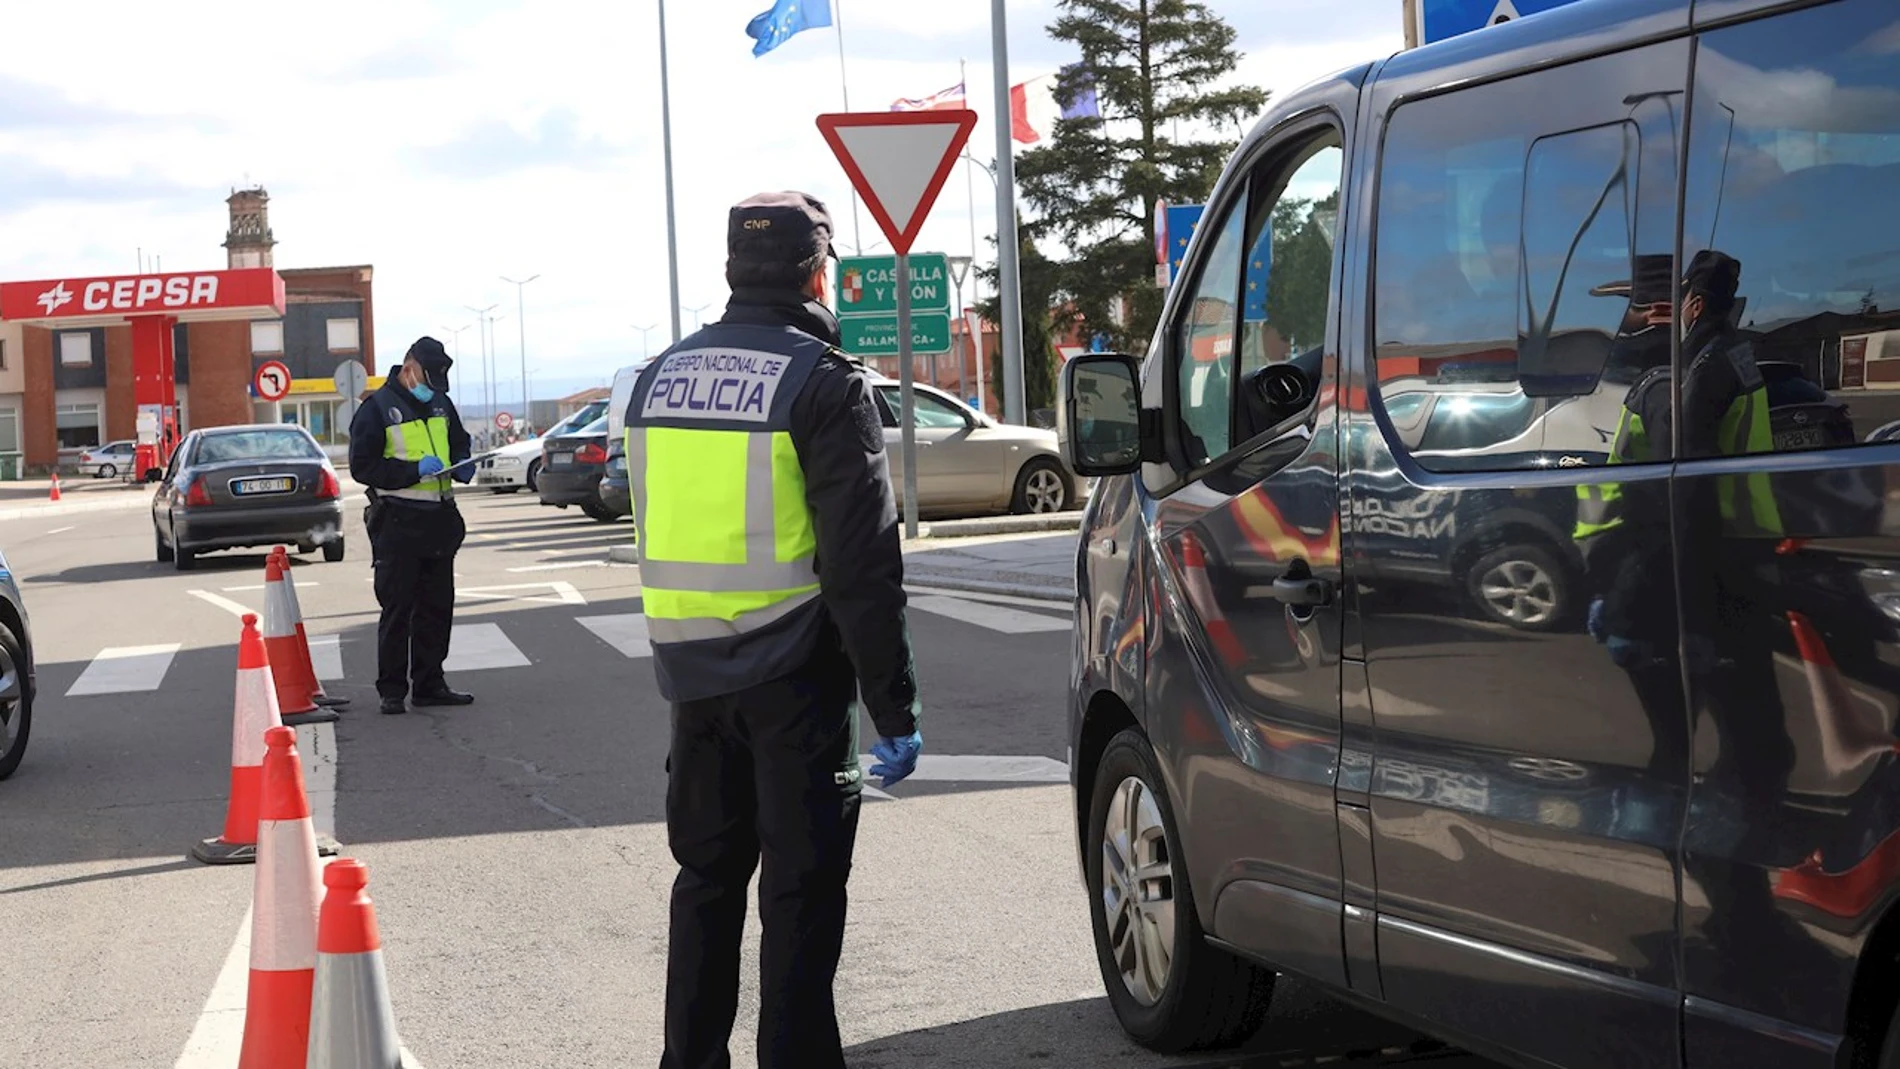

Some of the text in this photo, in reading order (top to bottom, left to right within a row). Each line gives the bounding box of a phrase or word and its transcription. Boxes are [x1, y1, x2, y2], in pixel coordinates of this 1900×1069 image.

[743, 219, 771, 230] CNP
[866, 266, 943, 283] CASILLA
[83, 275, 219, 311] CEPSA
[875, 283, 937, 302] Y LÓN
[858, 335, 929, 346] SALAMCA
[662, 354, 782, 377] CUERPO NACIONAL DE
[648, 377, 765, 414] POLICIA
